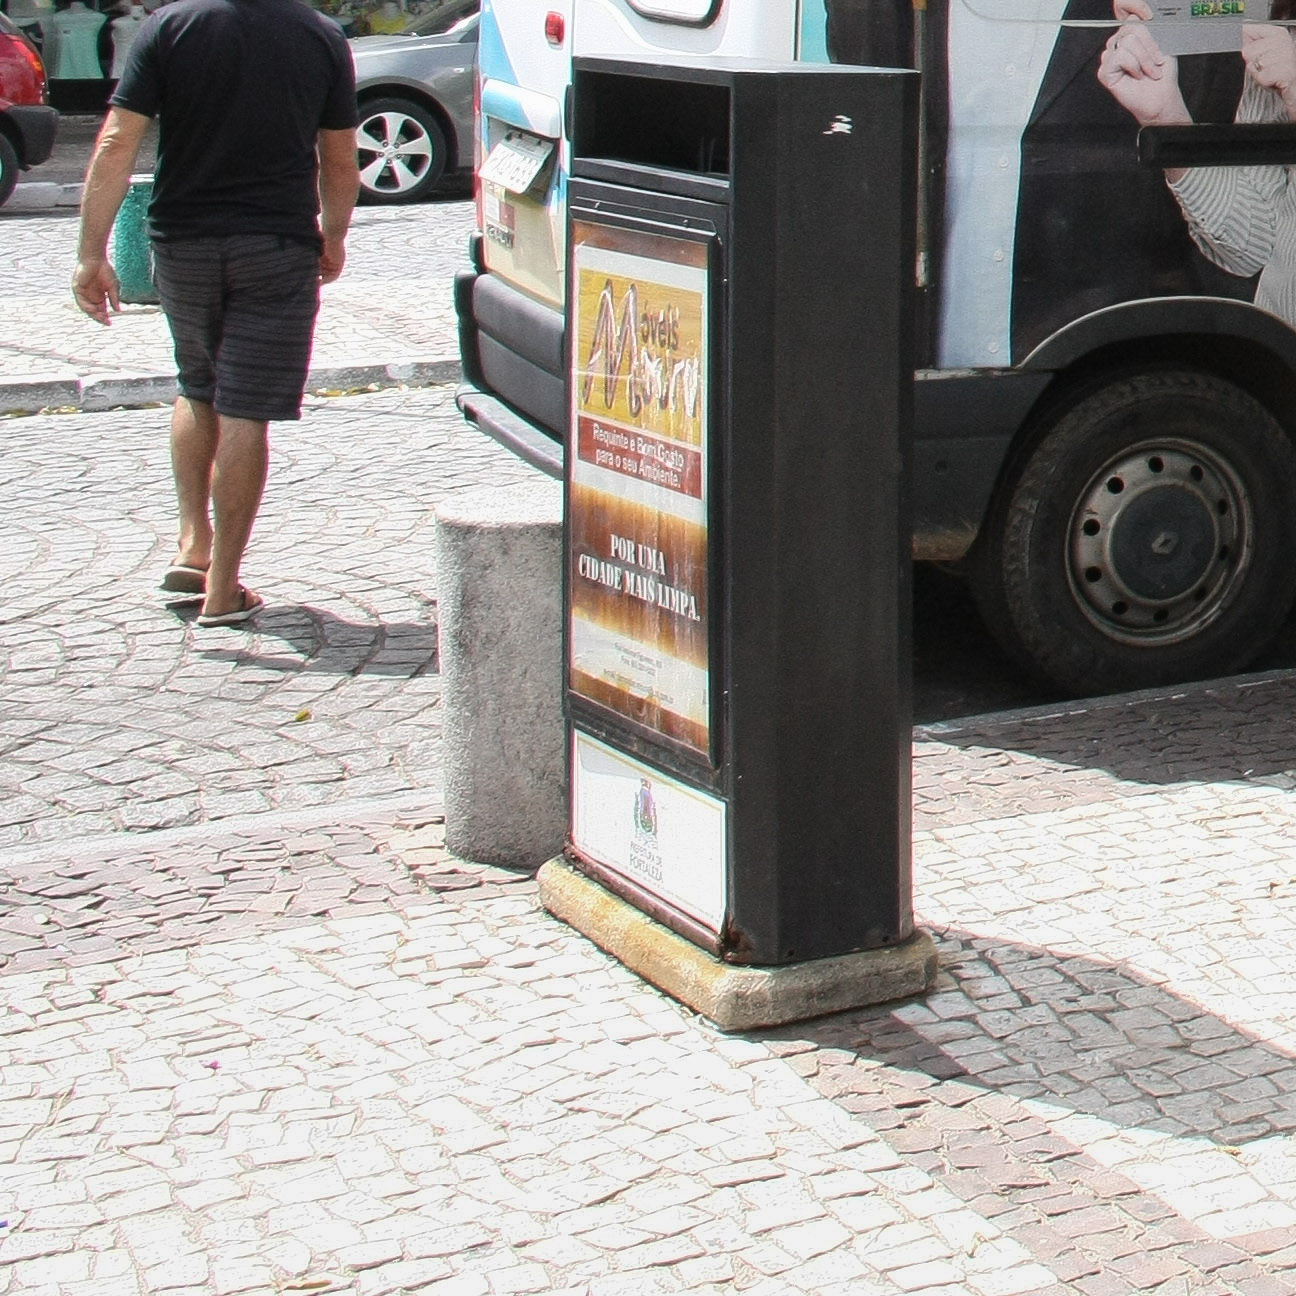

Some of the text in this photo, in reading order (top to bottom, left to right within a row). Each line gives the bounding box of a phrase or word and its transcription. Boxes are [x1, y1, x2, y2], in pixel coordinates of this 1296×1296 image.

[1191, 2, 1245, 16] BRASIL
[592, 422, 629, 451] Requinte
[595, 448, 614, 466] para
[610, 534, 666, 576] POR UMA
[578, 553, 701, 622] CIDADE MAIS LIMPA.
